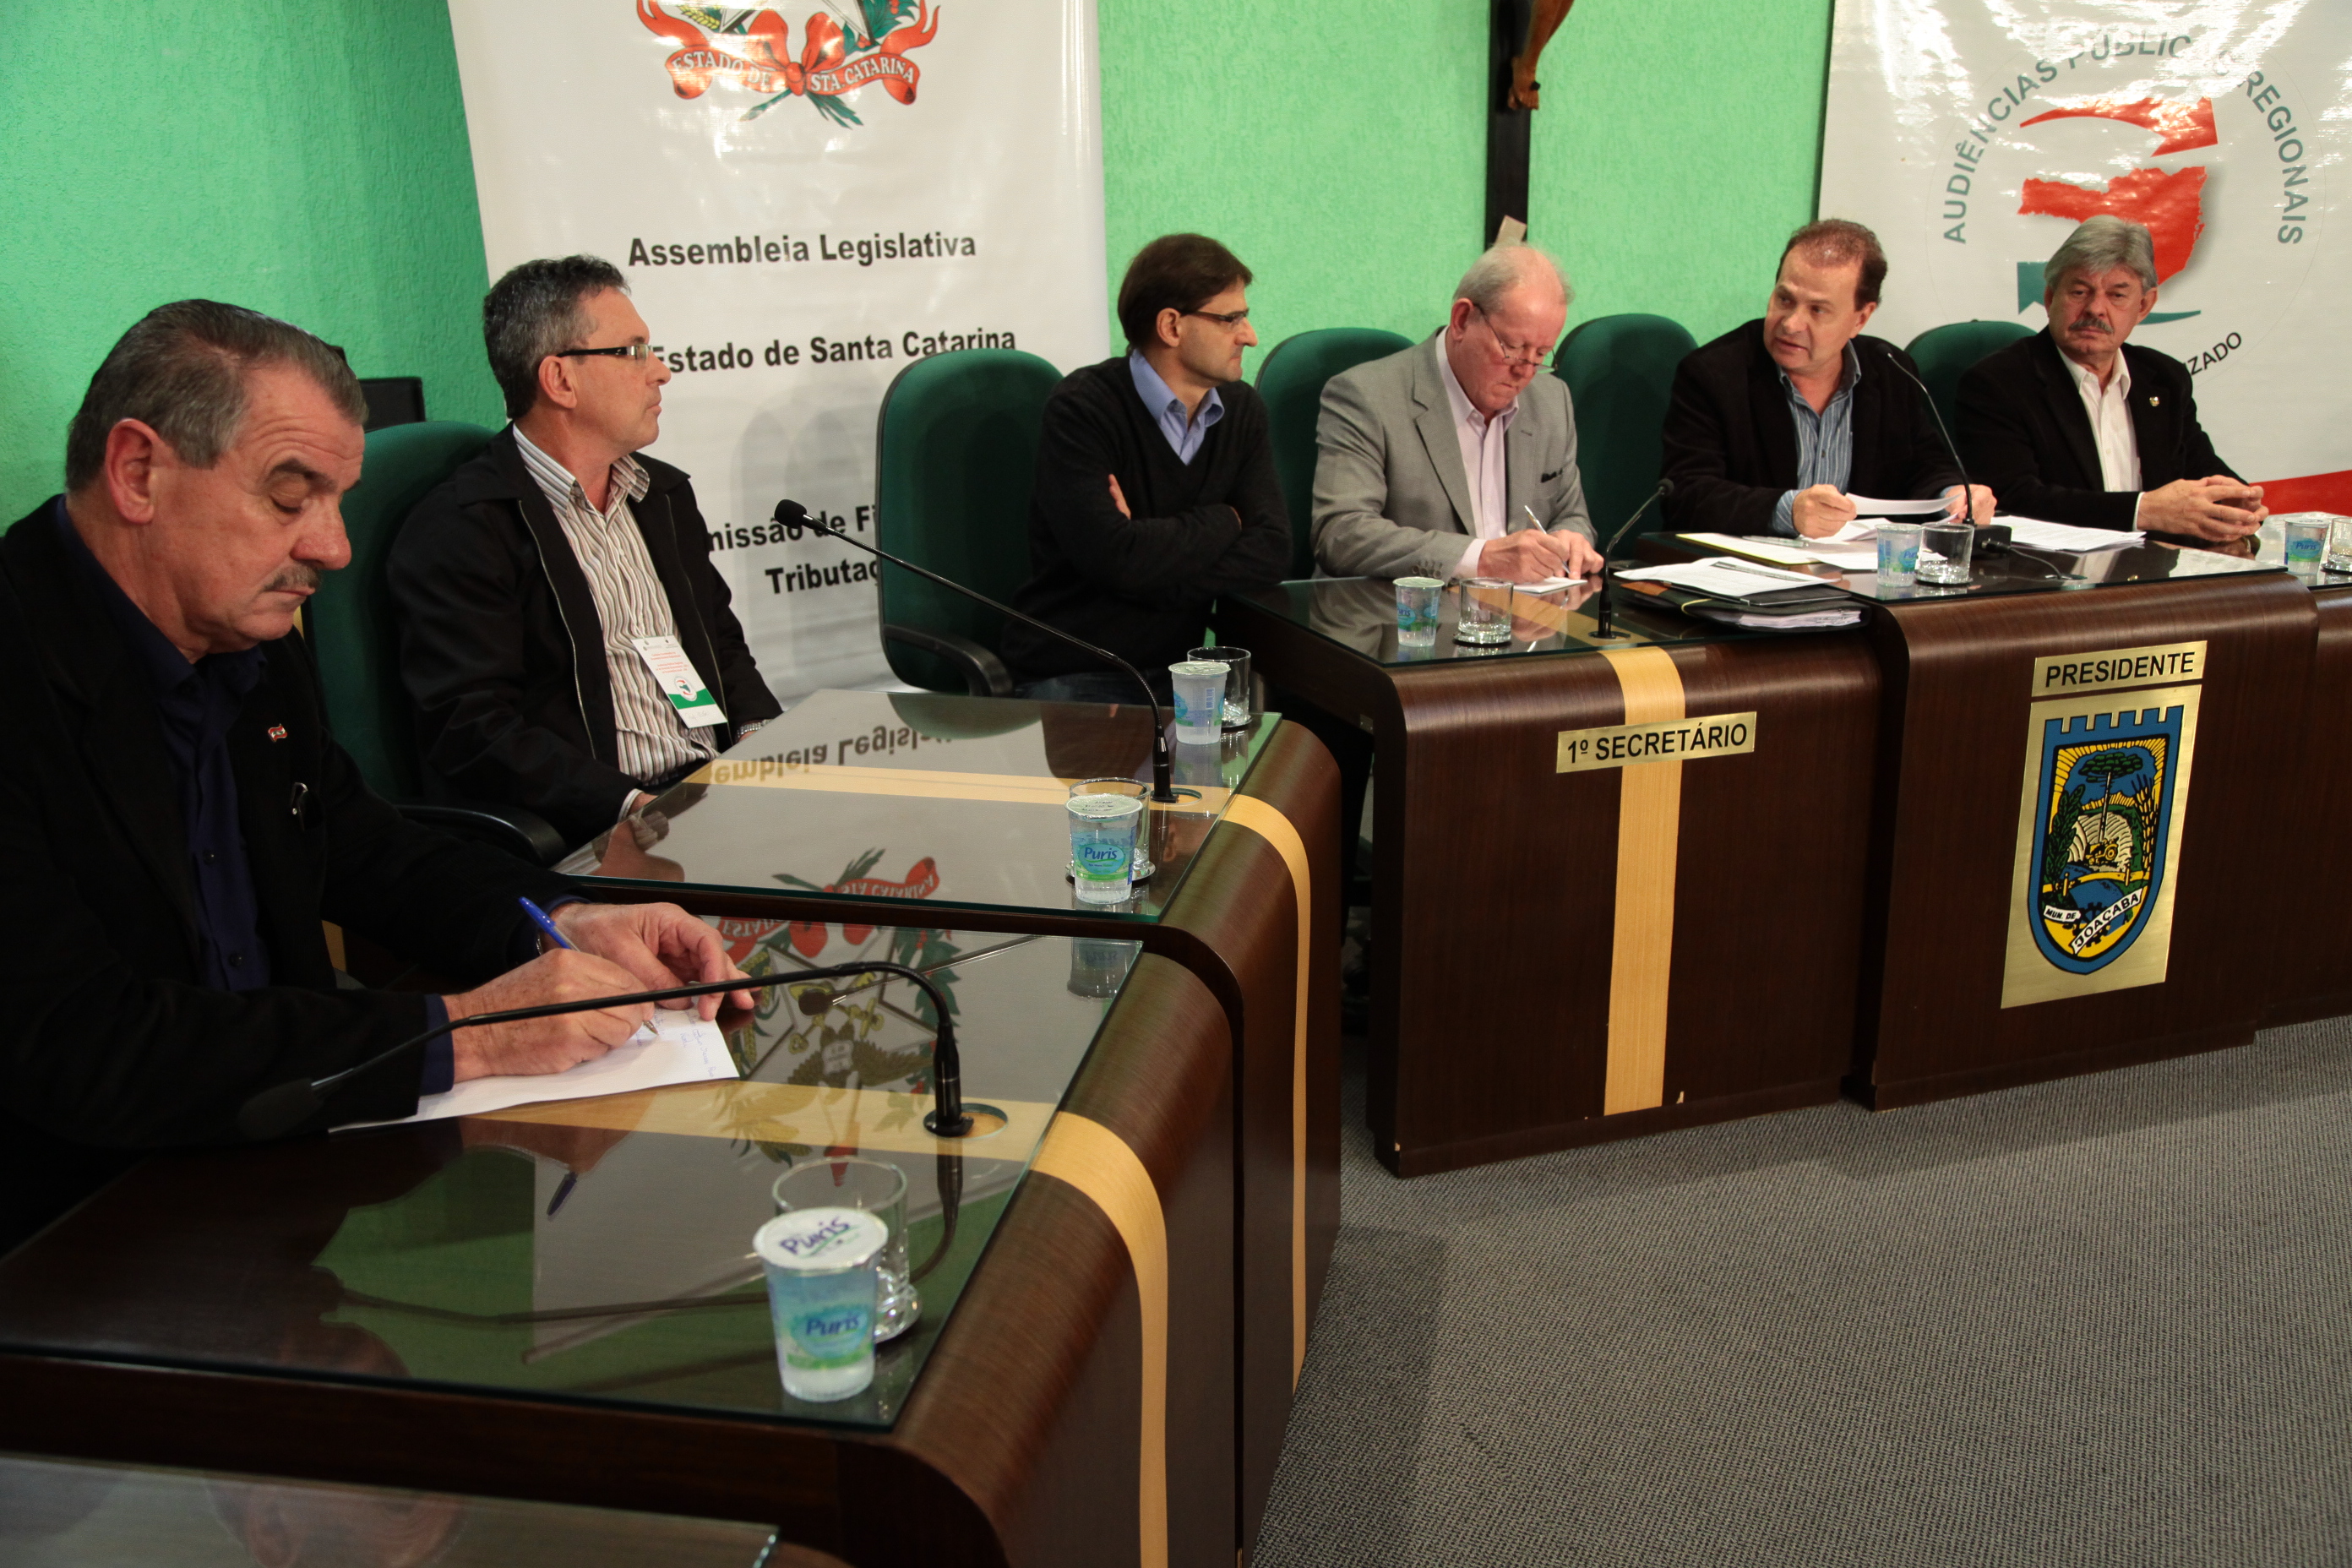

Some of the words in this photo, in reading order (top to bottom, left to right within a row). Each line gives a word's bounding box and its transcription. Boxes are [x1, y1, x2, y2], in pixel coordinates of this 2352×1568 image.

[672, 51, 744, 71] ESTADO
[748, 67, 772, 88] DE
[810, 74, 844, 91] STA
[845, 56, 915, 83] CATARINA
[1943, 59, 2057, 244] AUDIÊNCIAS
[2237, 71, 2310, 245] REGIONAIS
[629, 235, 810, 266] Assembleia
[819, 231, 976, 266] Legislativa
[765, 340, 800, 366] de
[810, 336, 893, 363] Santa
[2045, 651, 2196, 688] PRESIDENTE
[1567, 739, 1588, 764] 1º
[1595, 722, 1747, 760] SECRETÁRIO
[1084, 847, 1119, 860] Puris
[2066, 912, 2077, 920] DE
[2074, 893, 2139, 947] JOAÇABA
[779, 1216, 850, 1255] Puris
[806, 1311, 861, 1337] Puris
